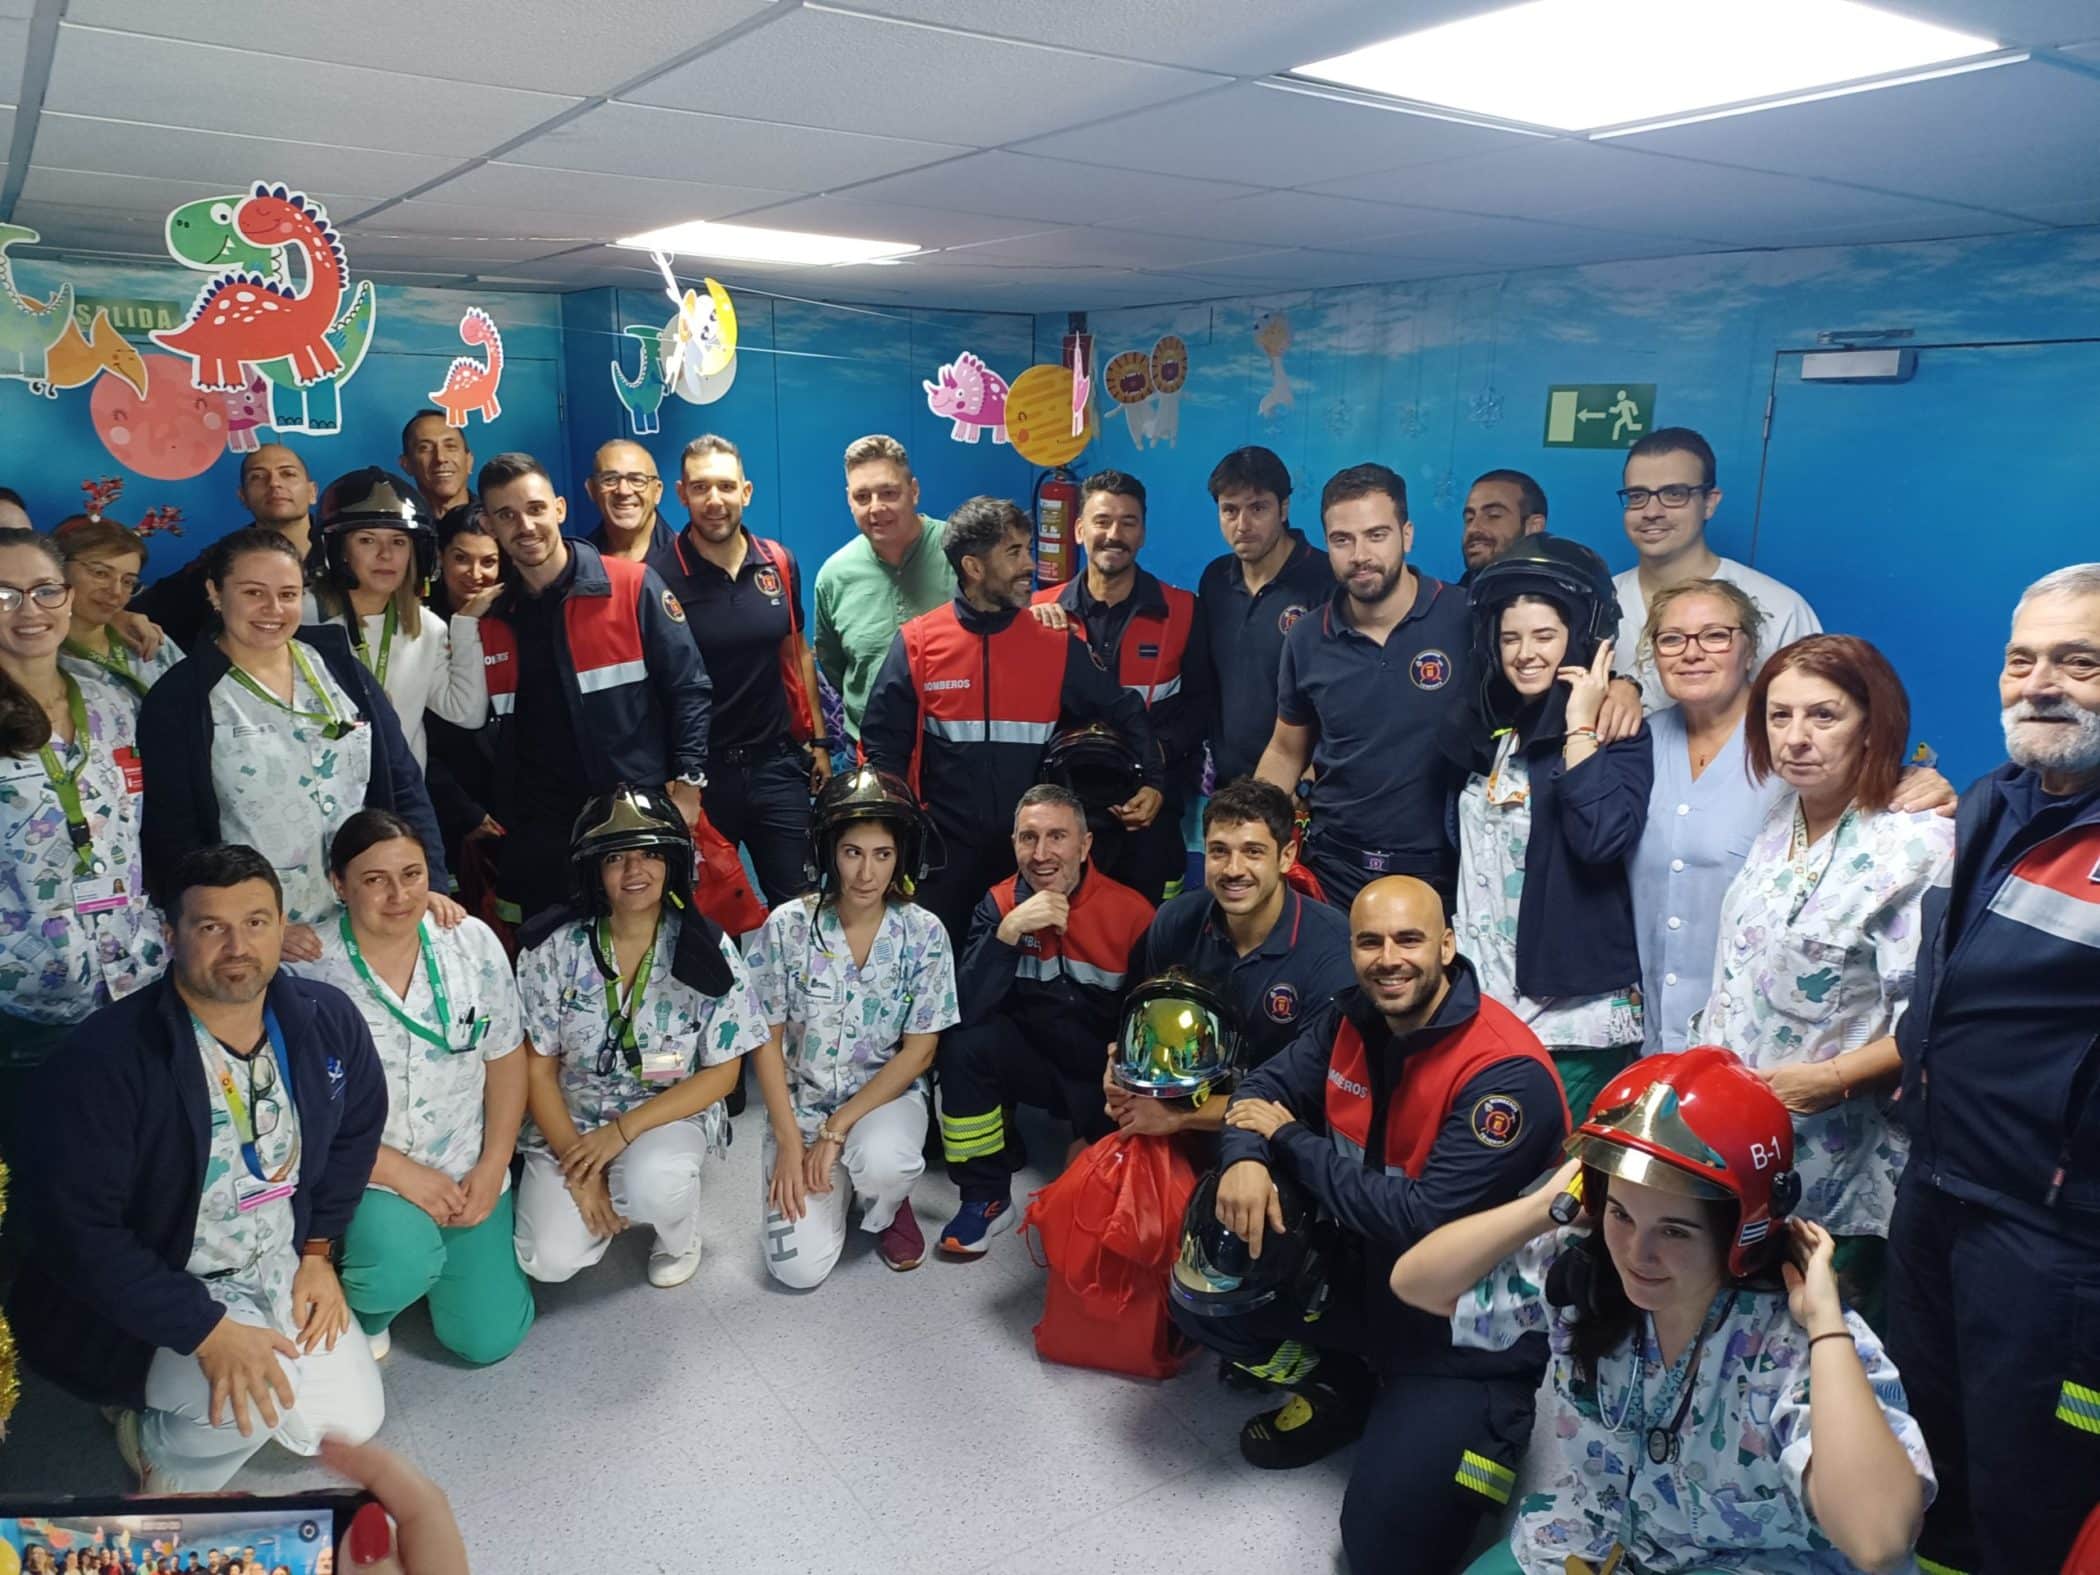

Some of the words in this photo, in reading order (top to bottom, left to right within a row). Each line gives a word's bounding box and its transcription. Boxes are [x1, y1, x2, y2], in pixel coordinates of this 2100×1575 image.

[76, 303, 172, 328] SLIDA
[923, 679, 970, 692] BOMBEROS
[1750, 1136, 1781, 1170] B-1
